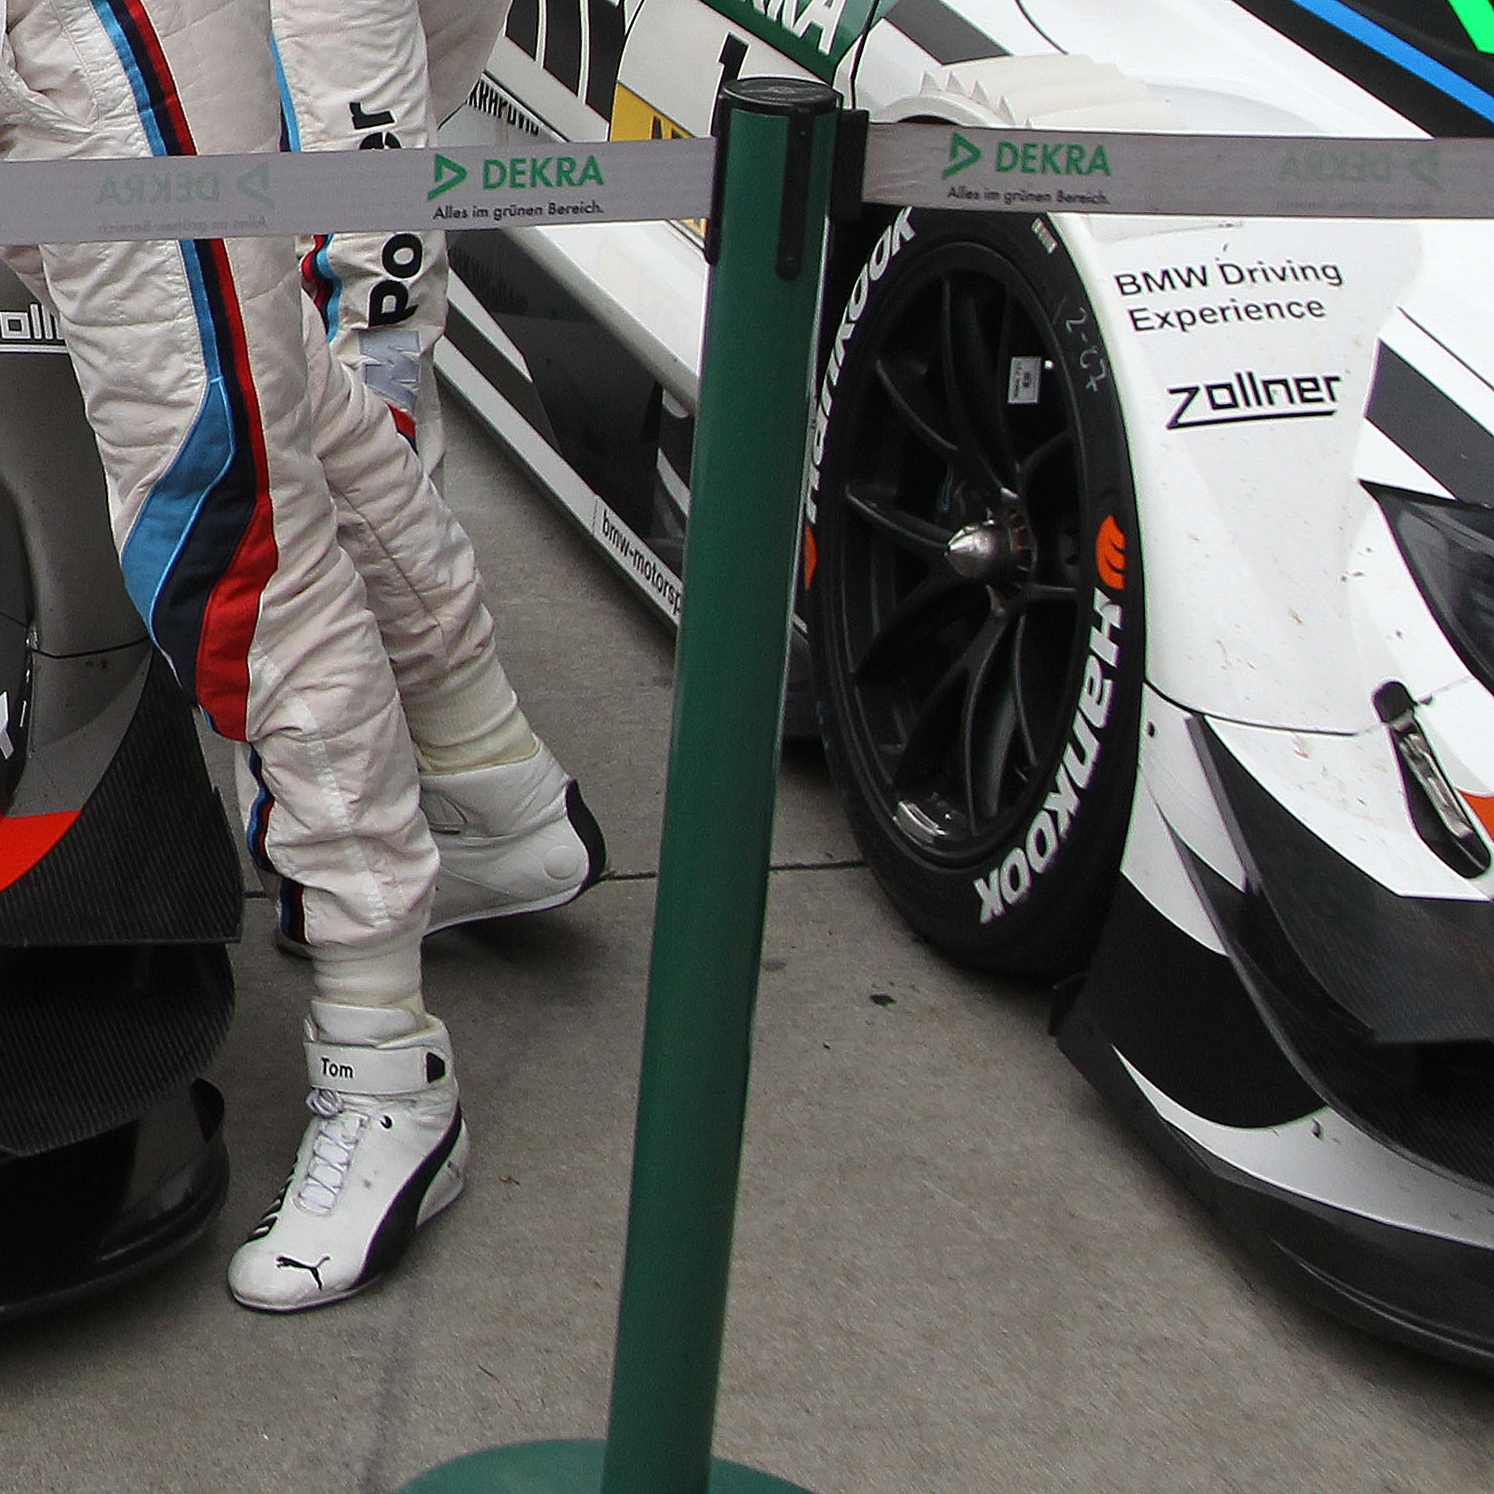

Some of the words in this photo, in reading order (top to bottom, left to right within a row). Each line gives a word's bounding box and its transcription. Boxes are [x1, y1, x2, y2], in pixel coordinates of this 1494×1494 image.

[483, 155, 604, 190] DEKRA
[995, 141, 1111, 176] DEKRA
[432, 205, 468, 220] Alles
[472, 205, 489, 218] im
[493, 205, 544, 222] grünen
[1114, 263, 1209, 297] BMW
[1218, 258, 1343, 289] Driving
[1128, 297, 1327, 335] Experience
[602, 508, 681, 615] bmw-motorsp
[320, 1056, 355, 1081] Tom
